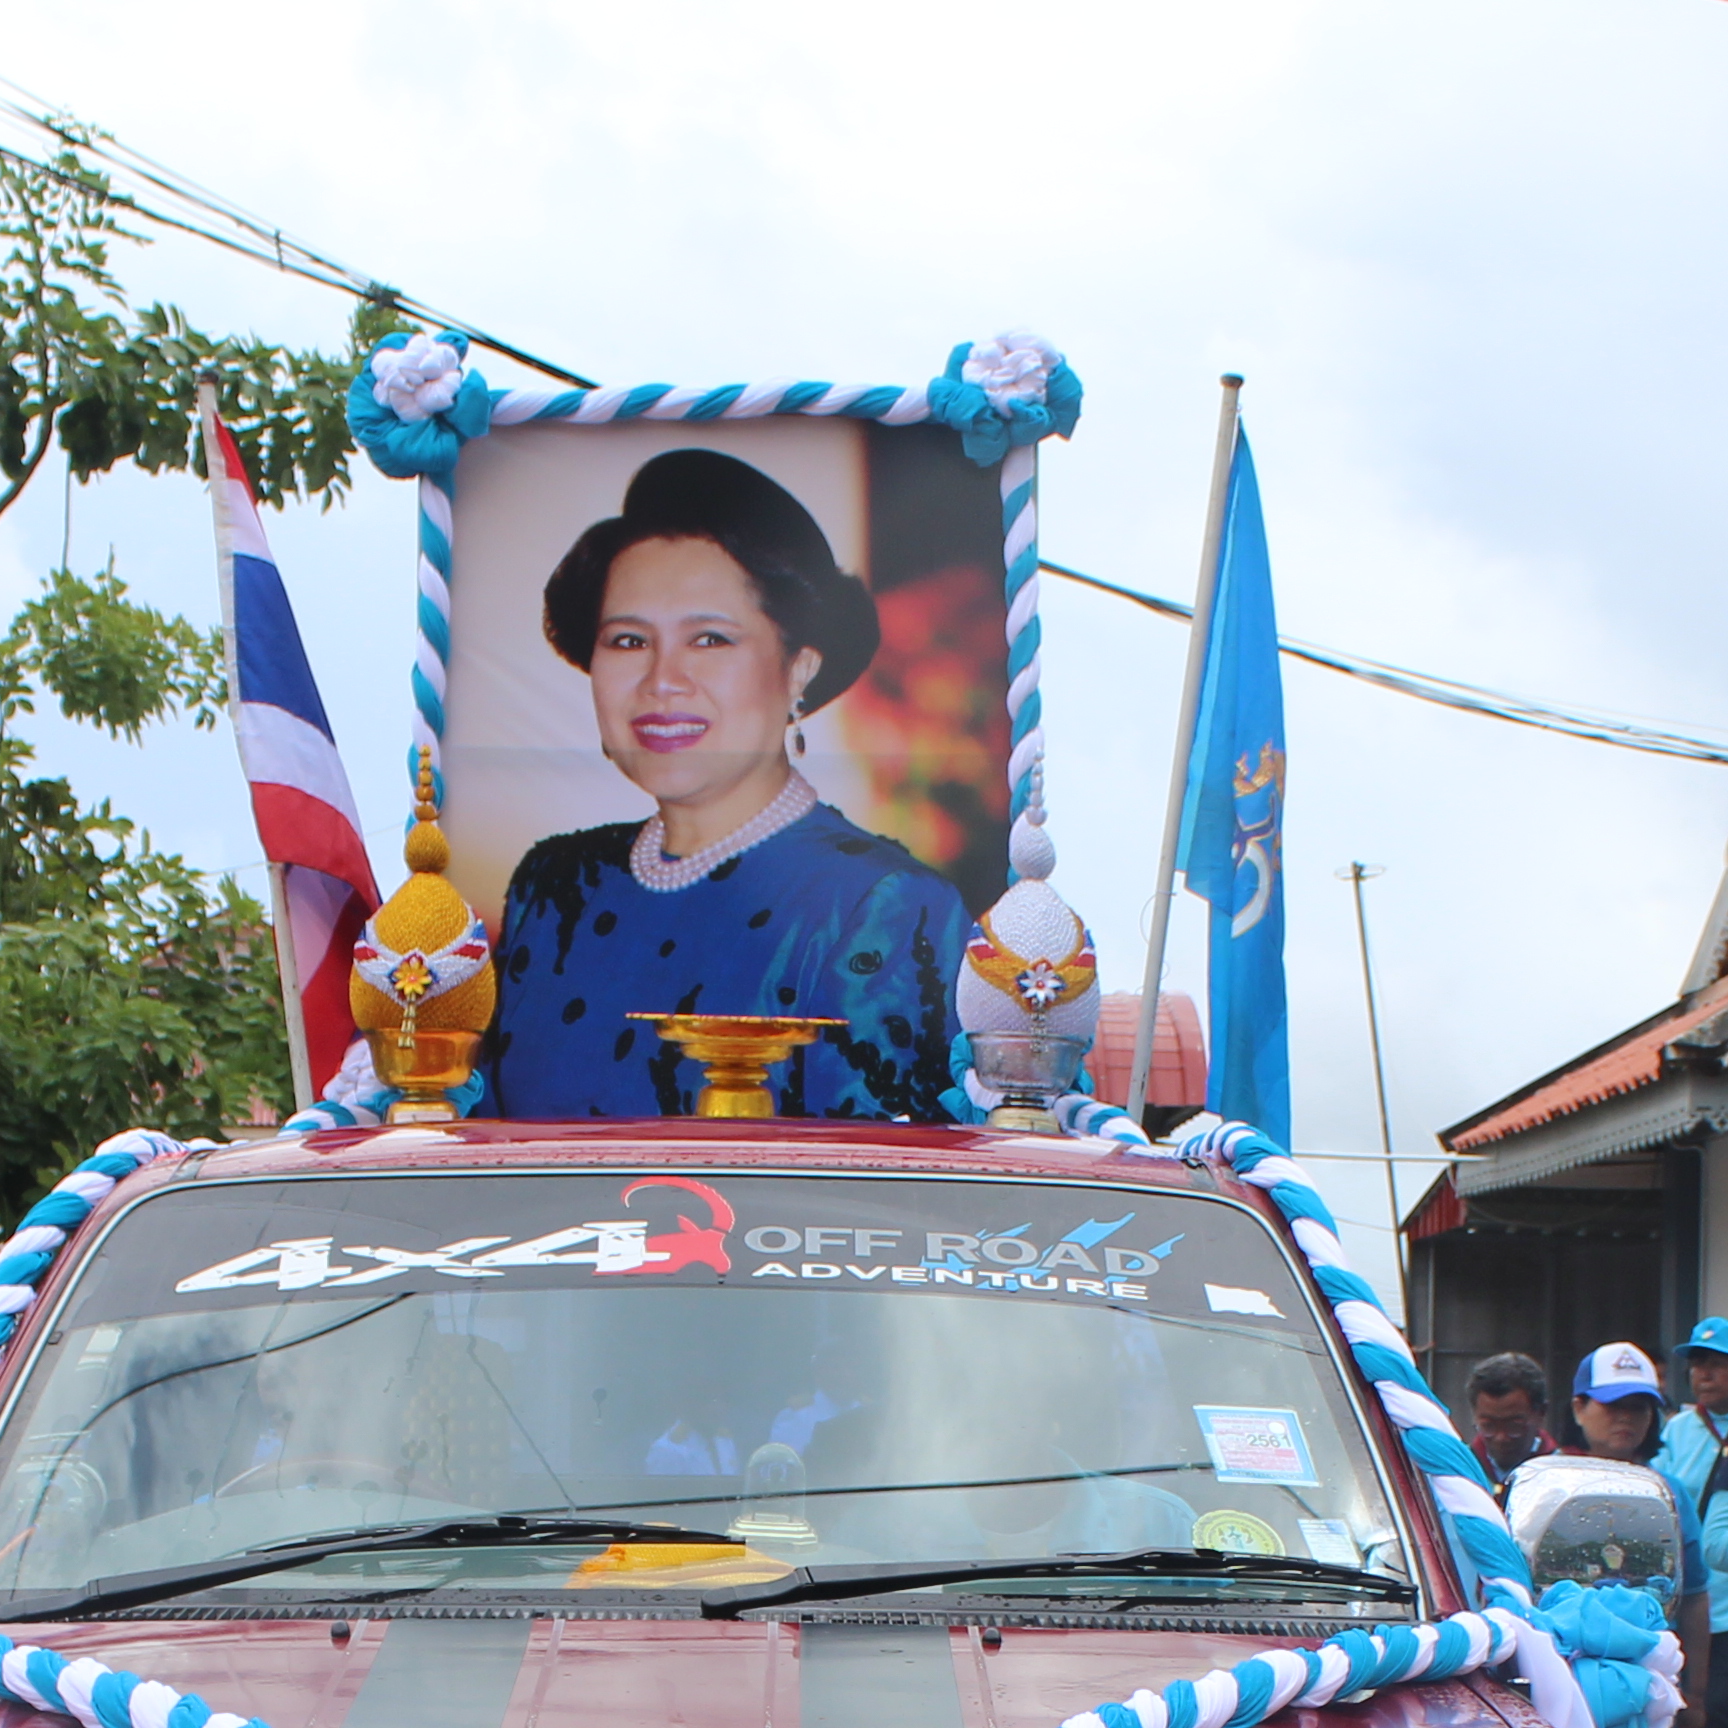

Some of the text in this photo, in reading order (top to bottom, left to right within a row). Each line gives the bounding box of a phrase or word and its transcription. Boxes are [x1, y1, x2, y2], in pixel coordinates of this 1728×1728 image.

[744, 1226, 1161, 1278] OFF ROAD
[751, 1261, 1150, 1301] ADVENTURE
[1246, 1433, 1292, 1449] 2561
